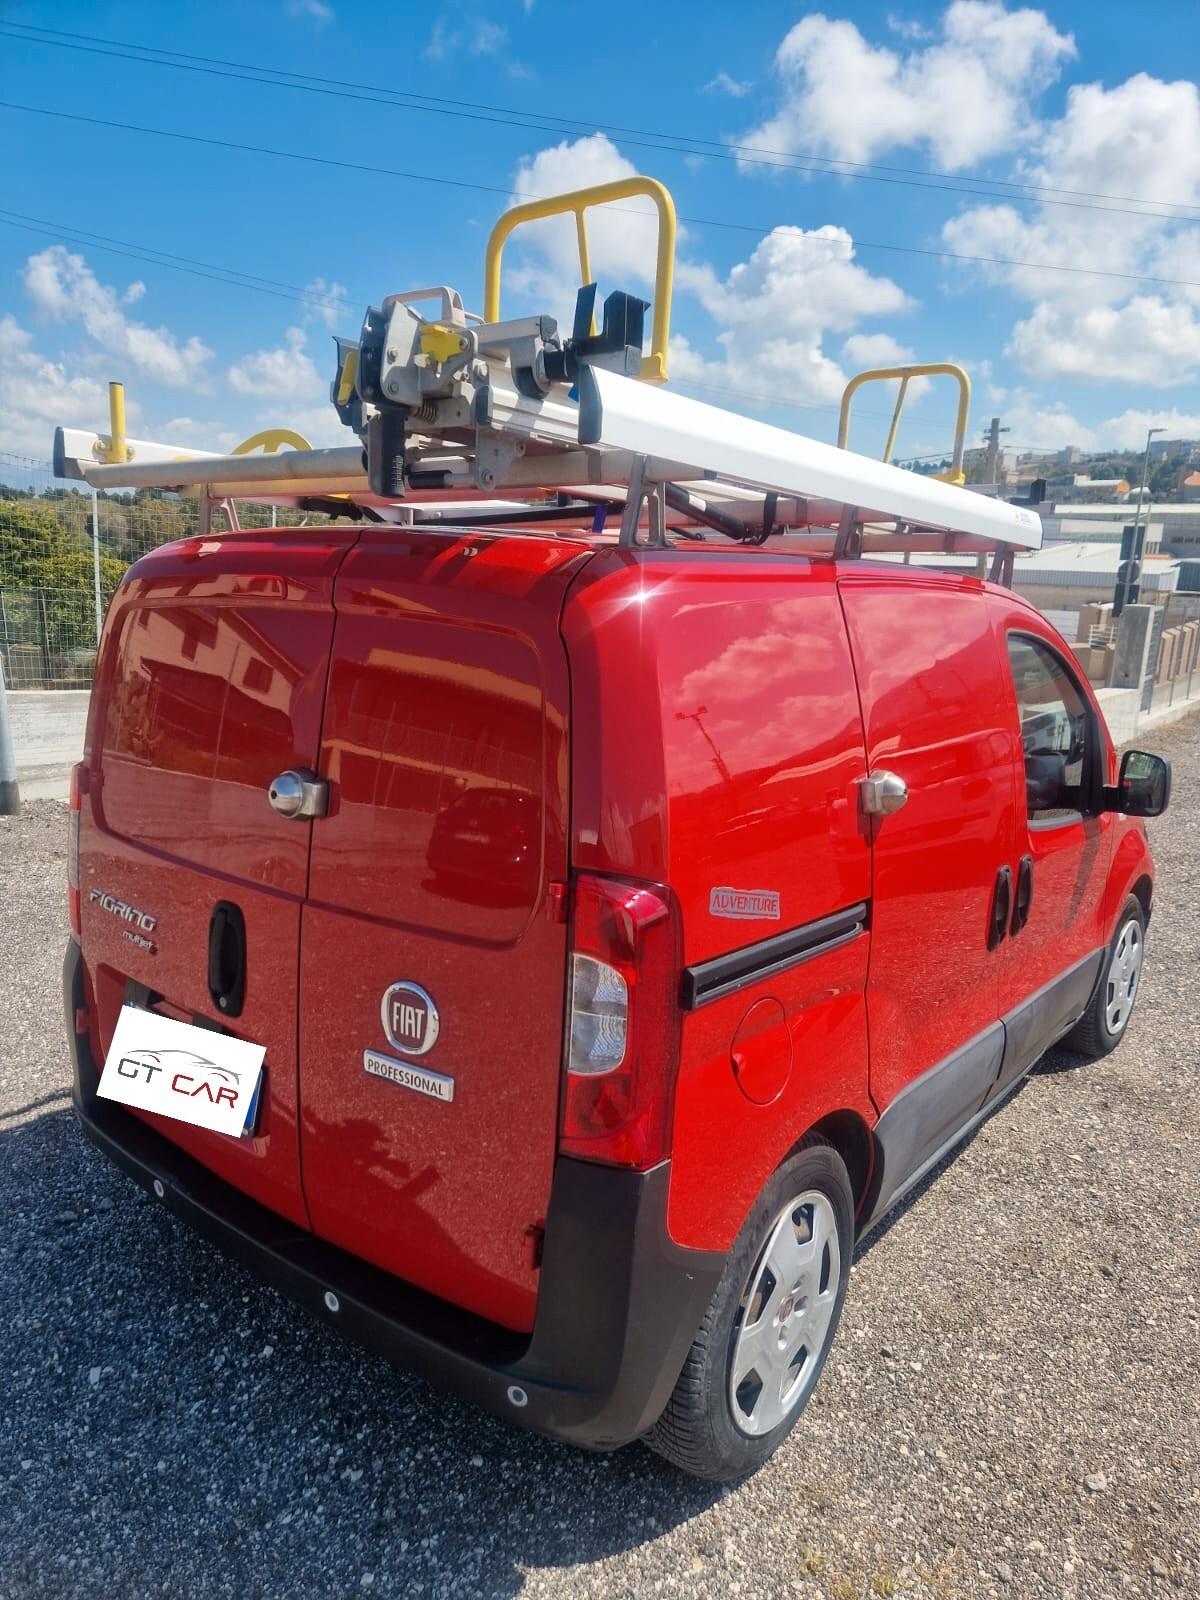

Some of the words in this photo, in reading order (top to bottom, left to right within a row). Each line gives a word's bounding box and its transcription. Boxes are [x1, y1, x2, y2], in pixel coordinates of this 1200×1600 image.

[712, 893, 777, 912] ADVENTURE
[393, 1001, 425, 1039] FIAT
[367, 1058, 444, 1096] PROFESSIONAL
